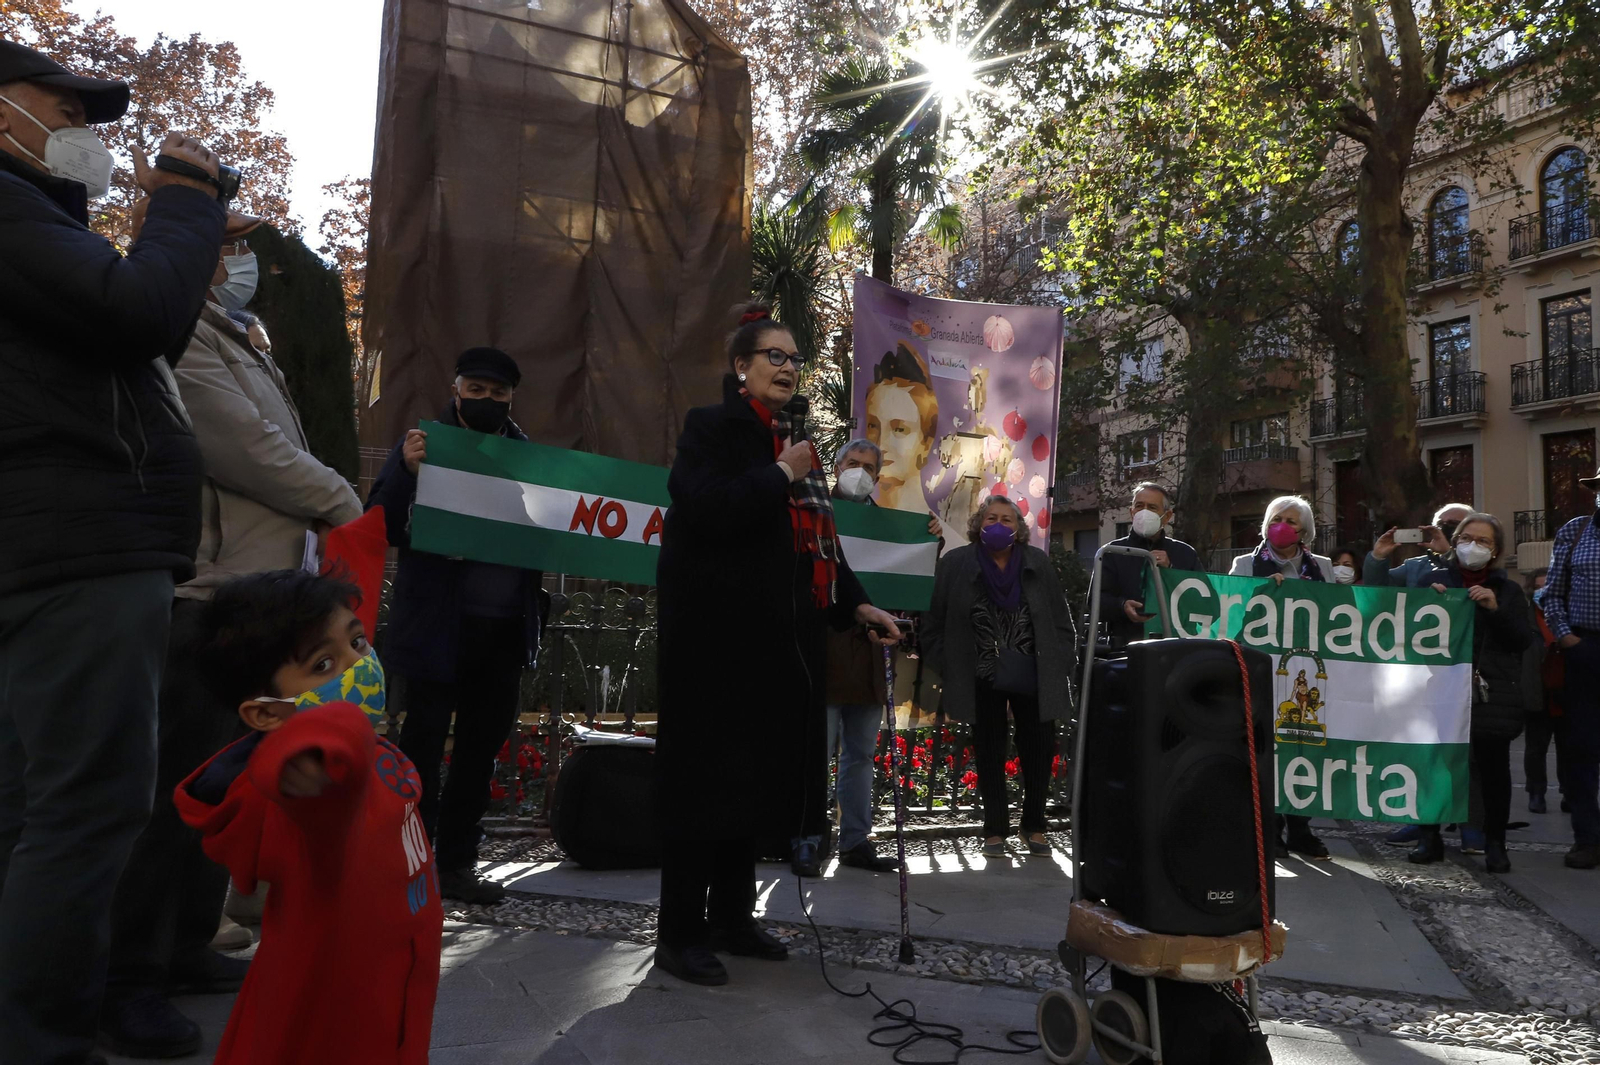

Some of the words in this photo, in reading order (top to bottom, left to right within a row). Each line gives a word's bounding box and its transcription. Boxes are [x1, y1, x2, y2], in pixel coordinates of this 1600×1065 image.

[930, 327, 959, 342] Granada
[960, 331, 984, 345] Abierta
[569, 494, 628, 539] NO
[1170, 577, 1451, 662] Granada
[407, 873, 428, 916] NO
[1207, 890, 1234, 900] ibiza
